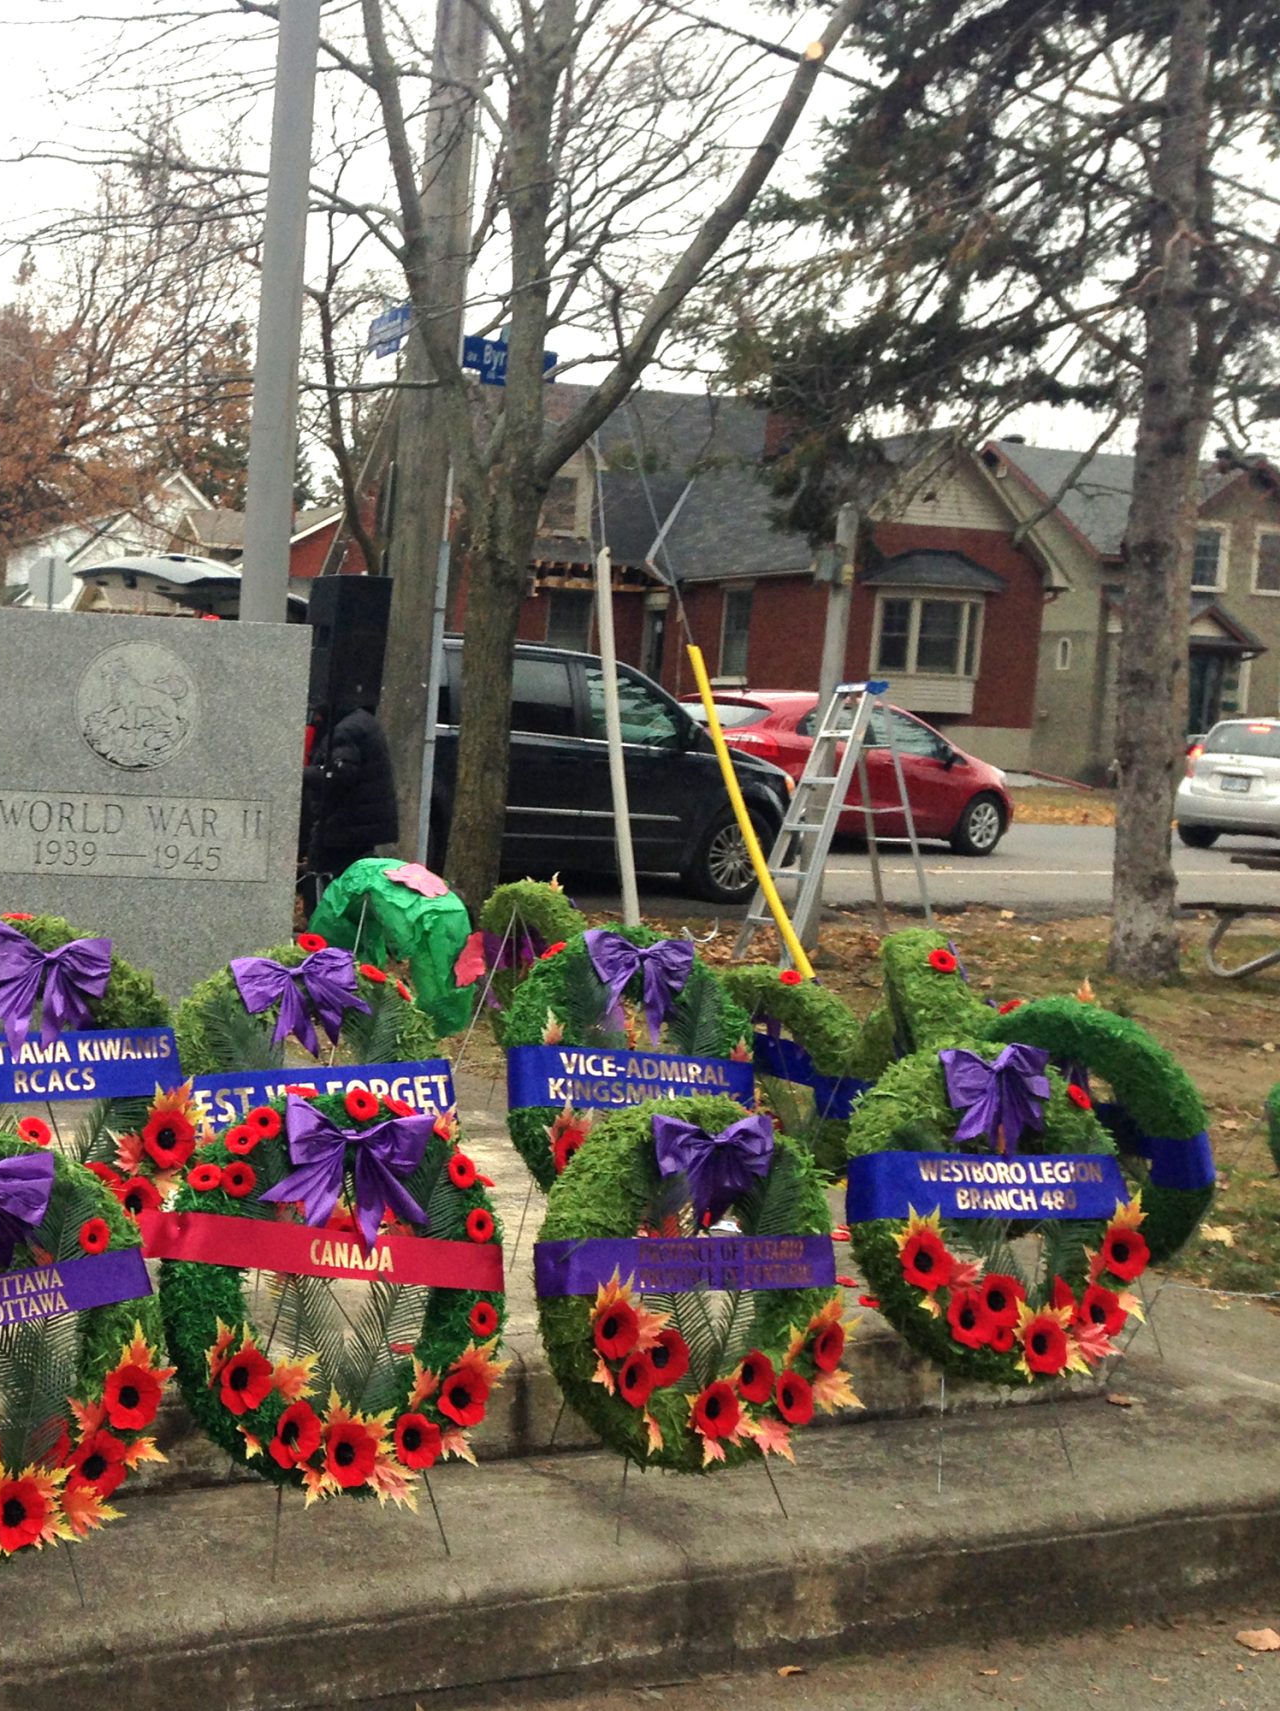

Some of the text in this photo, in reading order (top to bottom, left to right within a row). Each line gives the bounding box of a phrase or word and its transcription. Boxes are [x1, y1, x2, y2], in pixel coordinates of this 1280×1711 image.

[483, 345, 507, 371] Byr
[146, 805, 219, 838] WAR
[243, 809, 263, 839] II
[78, 1035, 171, 1062] KIWANIS
[14, 1069, 97, 1095] RCACS
[559, 1052, 731, 1086] VICE-ADMIRAL
[194, 1087, 254, 1124] EST
[918, 1159, 1103, 1184] WESTBORO LEGION
[956, 1188, 1077, 1211] BRANCH 480
[310, 1239, 395, 1273] CANADA
